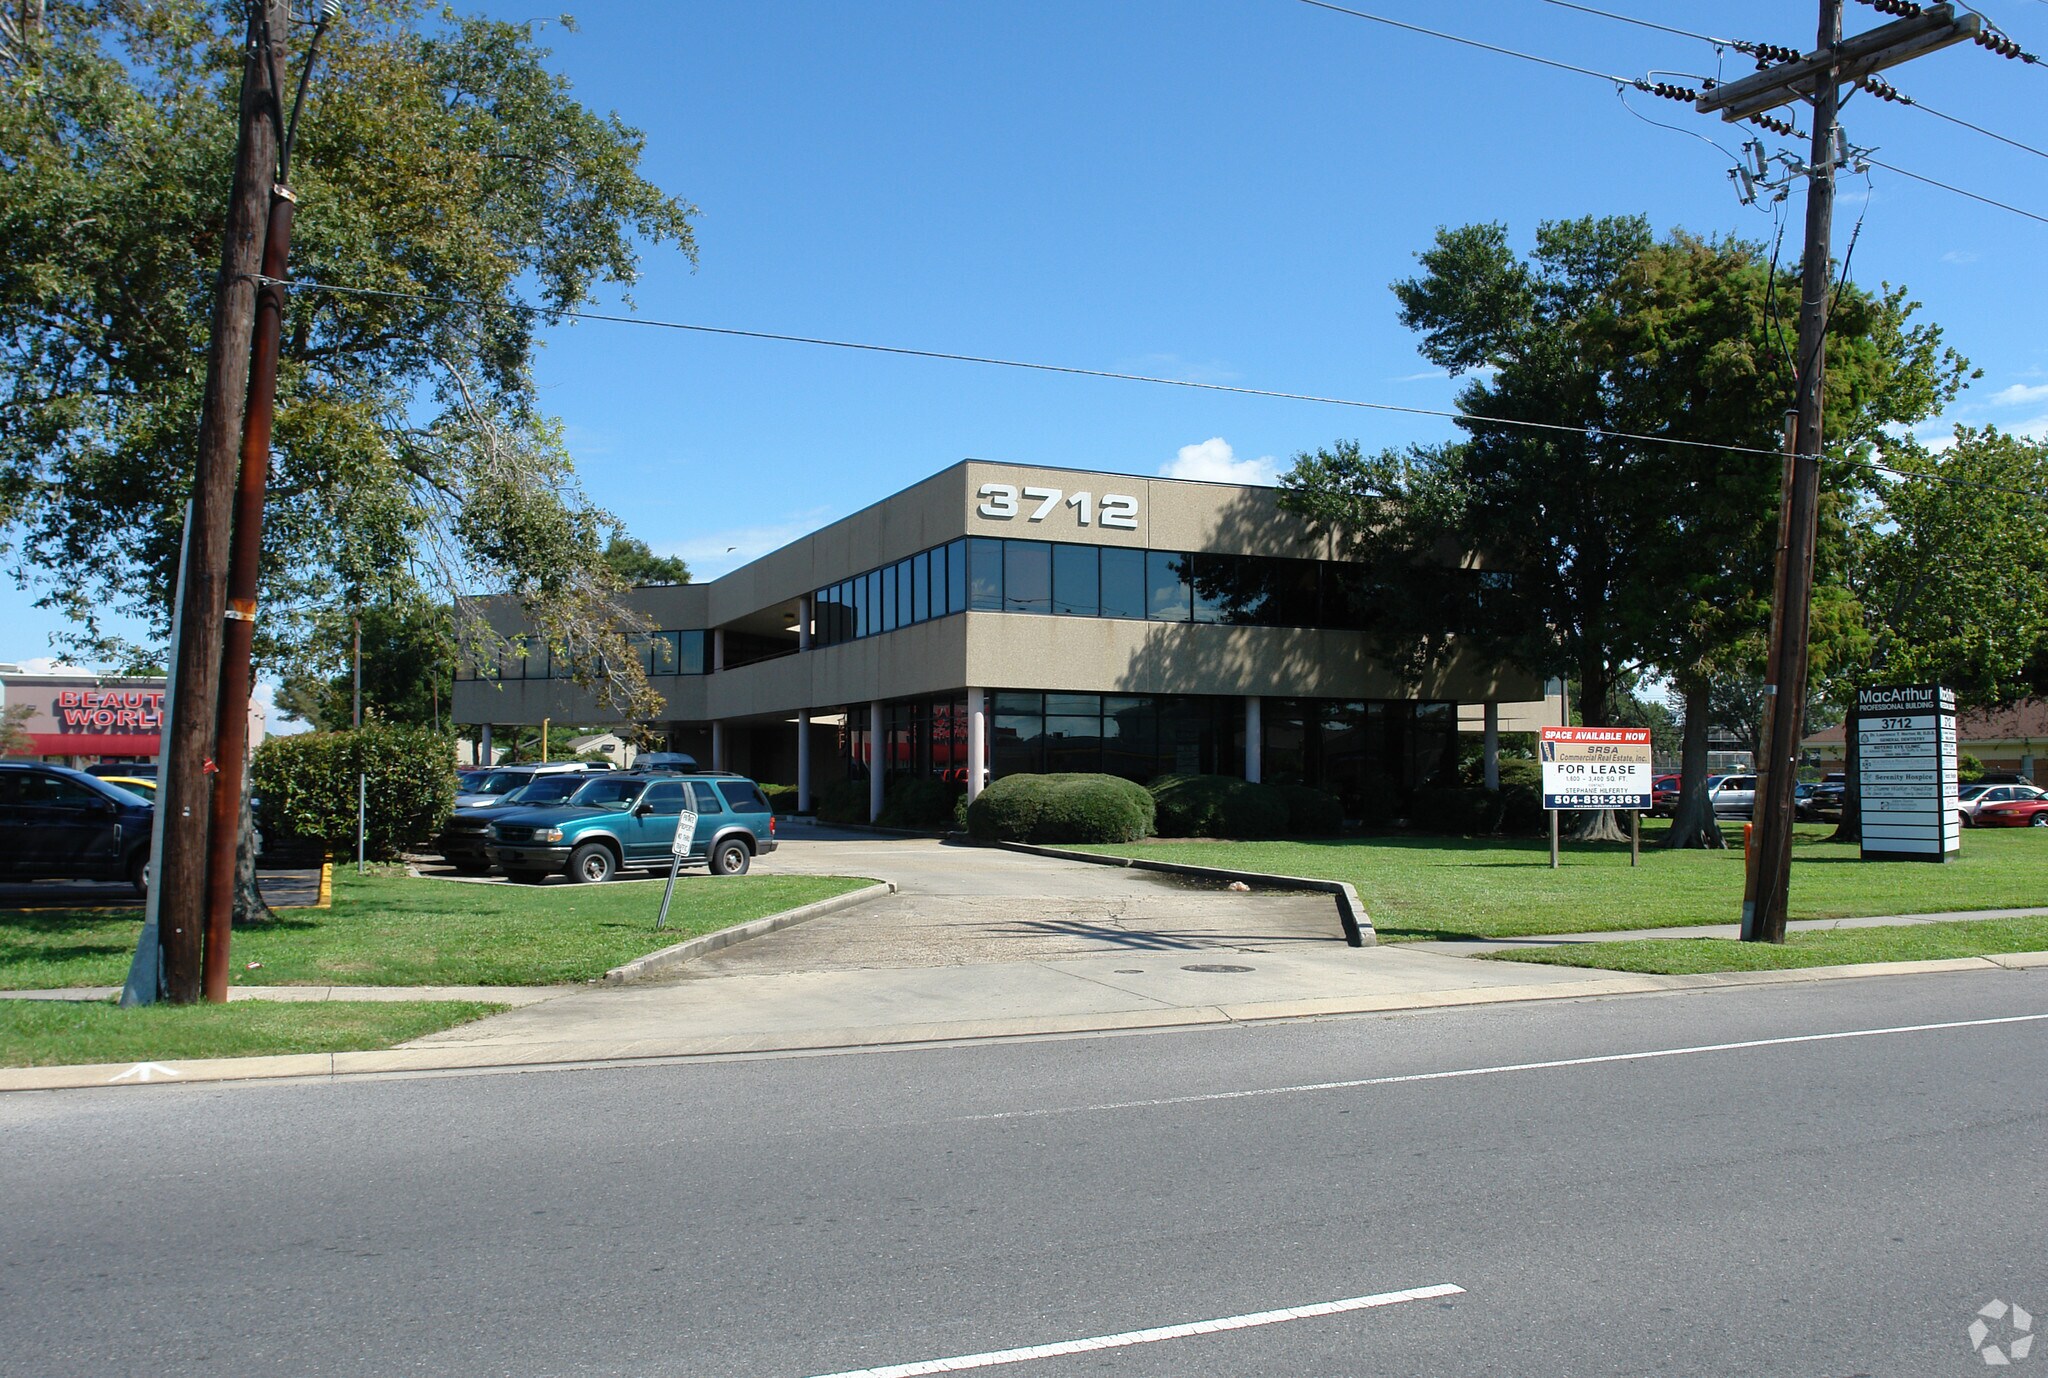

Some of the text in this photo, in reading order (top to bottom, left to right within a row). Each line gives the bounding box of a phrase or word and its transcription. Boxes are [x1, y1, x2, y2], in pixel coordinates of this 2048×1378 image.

[979, 483, 1139, 528] 3712
[59, 691, 164, 708] BEAUT
[1860, 687, 1933, 703] MacArthur
[1859, 702, 1905, 711] PROFESSIONAL
[1905, 701, 1934, 709] BUILDING
[1882, 718, 1912, 729] 3712
[1545, 731, 1572, 740] SPACE
[1575, 732, 1622, 740] AVAILABLE
[1588, 746, 1619, 754] SRSA
[1560, 753, 1597, 761] Commercial
[1612, 754, 1634, 762] Estate,
[1558, 765, 1636, 774] FOR LEASE
[1905, 773, 1933, 781] Hospice
[1555, 795, 1640, 804] 504-831-2363
